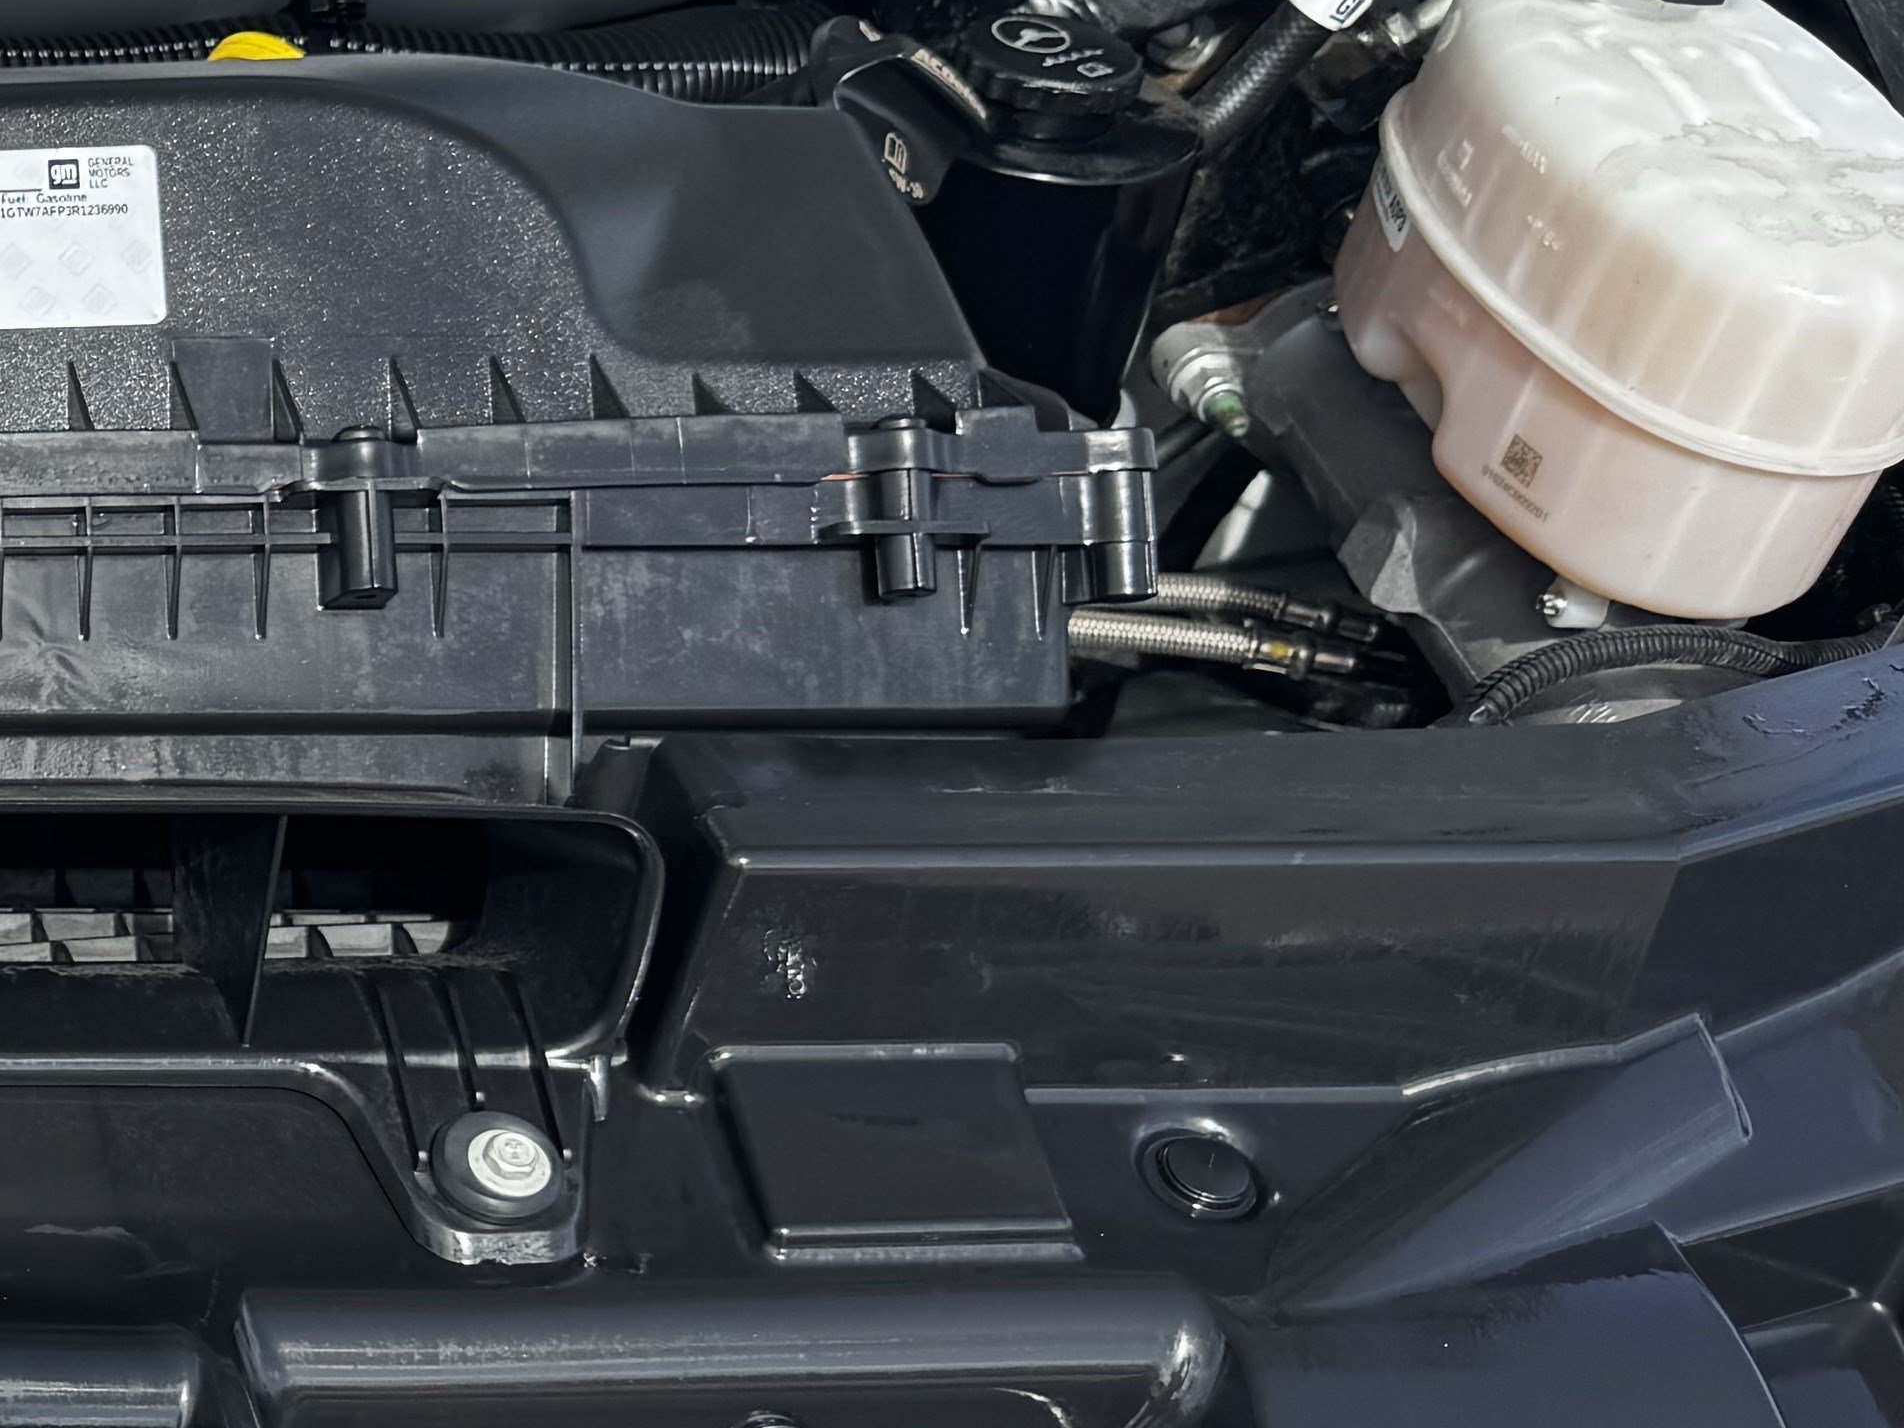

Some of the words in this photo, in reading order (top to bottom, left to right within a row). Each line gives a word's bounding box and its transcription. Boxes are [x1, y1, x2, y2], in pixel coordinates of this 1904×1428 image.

[88, 157, 134, 167] GENERAL
[89, 167, 130, 177] MOTORS
[90, 178, 108, 188] LLC
[36, 193, 87, 203] Gasoline
